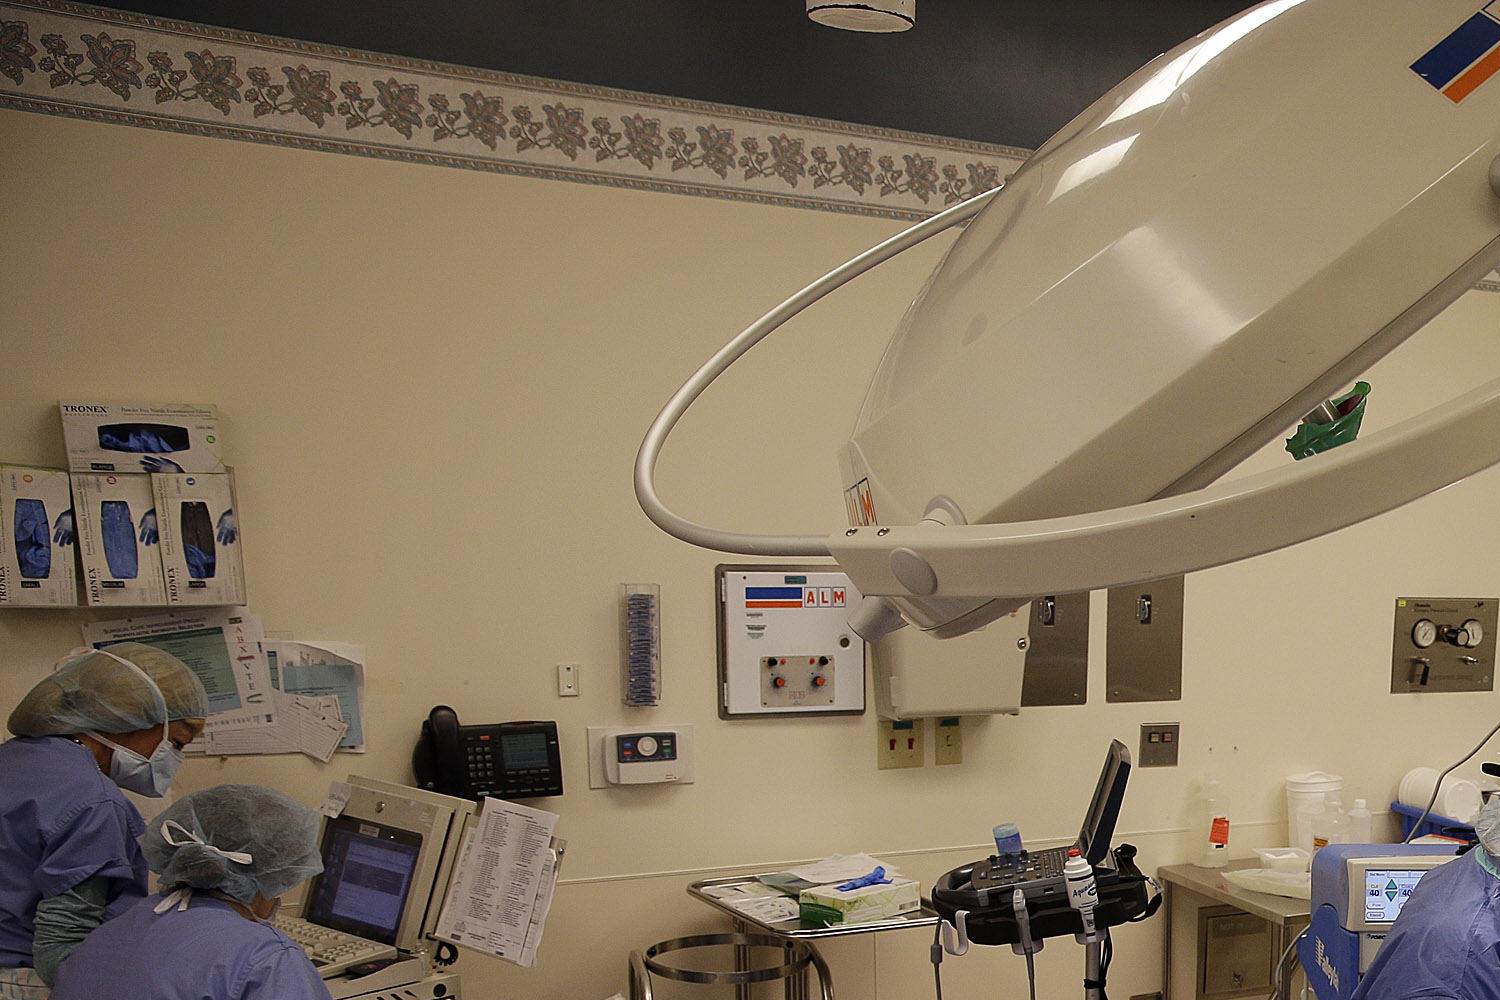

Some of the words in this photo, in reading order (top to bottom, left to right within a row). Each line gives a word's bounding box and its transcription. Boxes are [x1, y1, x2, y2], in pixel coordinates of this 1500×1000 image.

[63, 405, 107, 413] TRONEX
[88, 567, 100, 603] TRONEX
[168, 567, 178, 601] TRONEX
[806, 591, 845, 604] ALM
[1369, 889, 1380, 897] 40
[1402, 889, 1413, 897] 40
